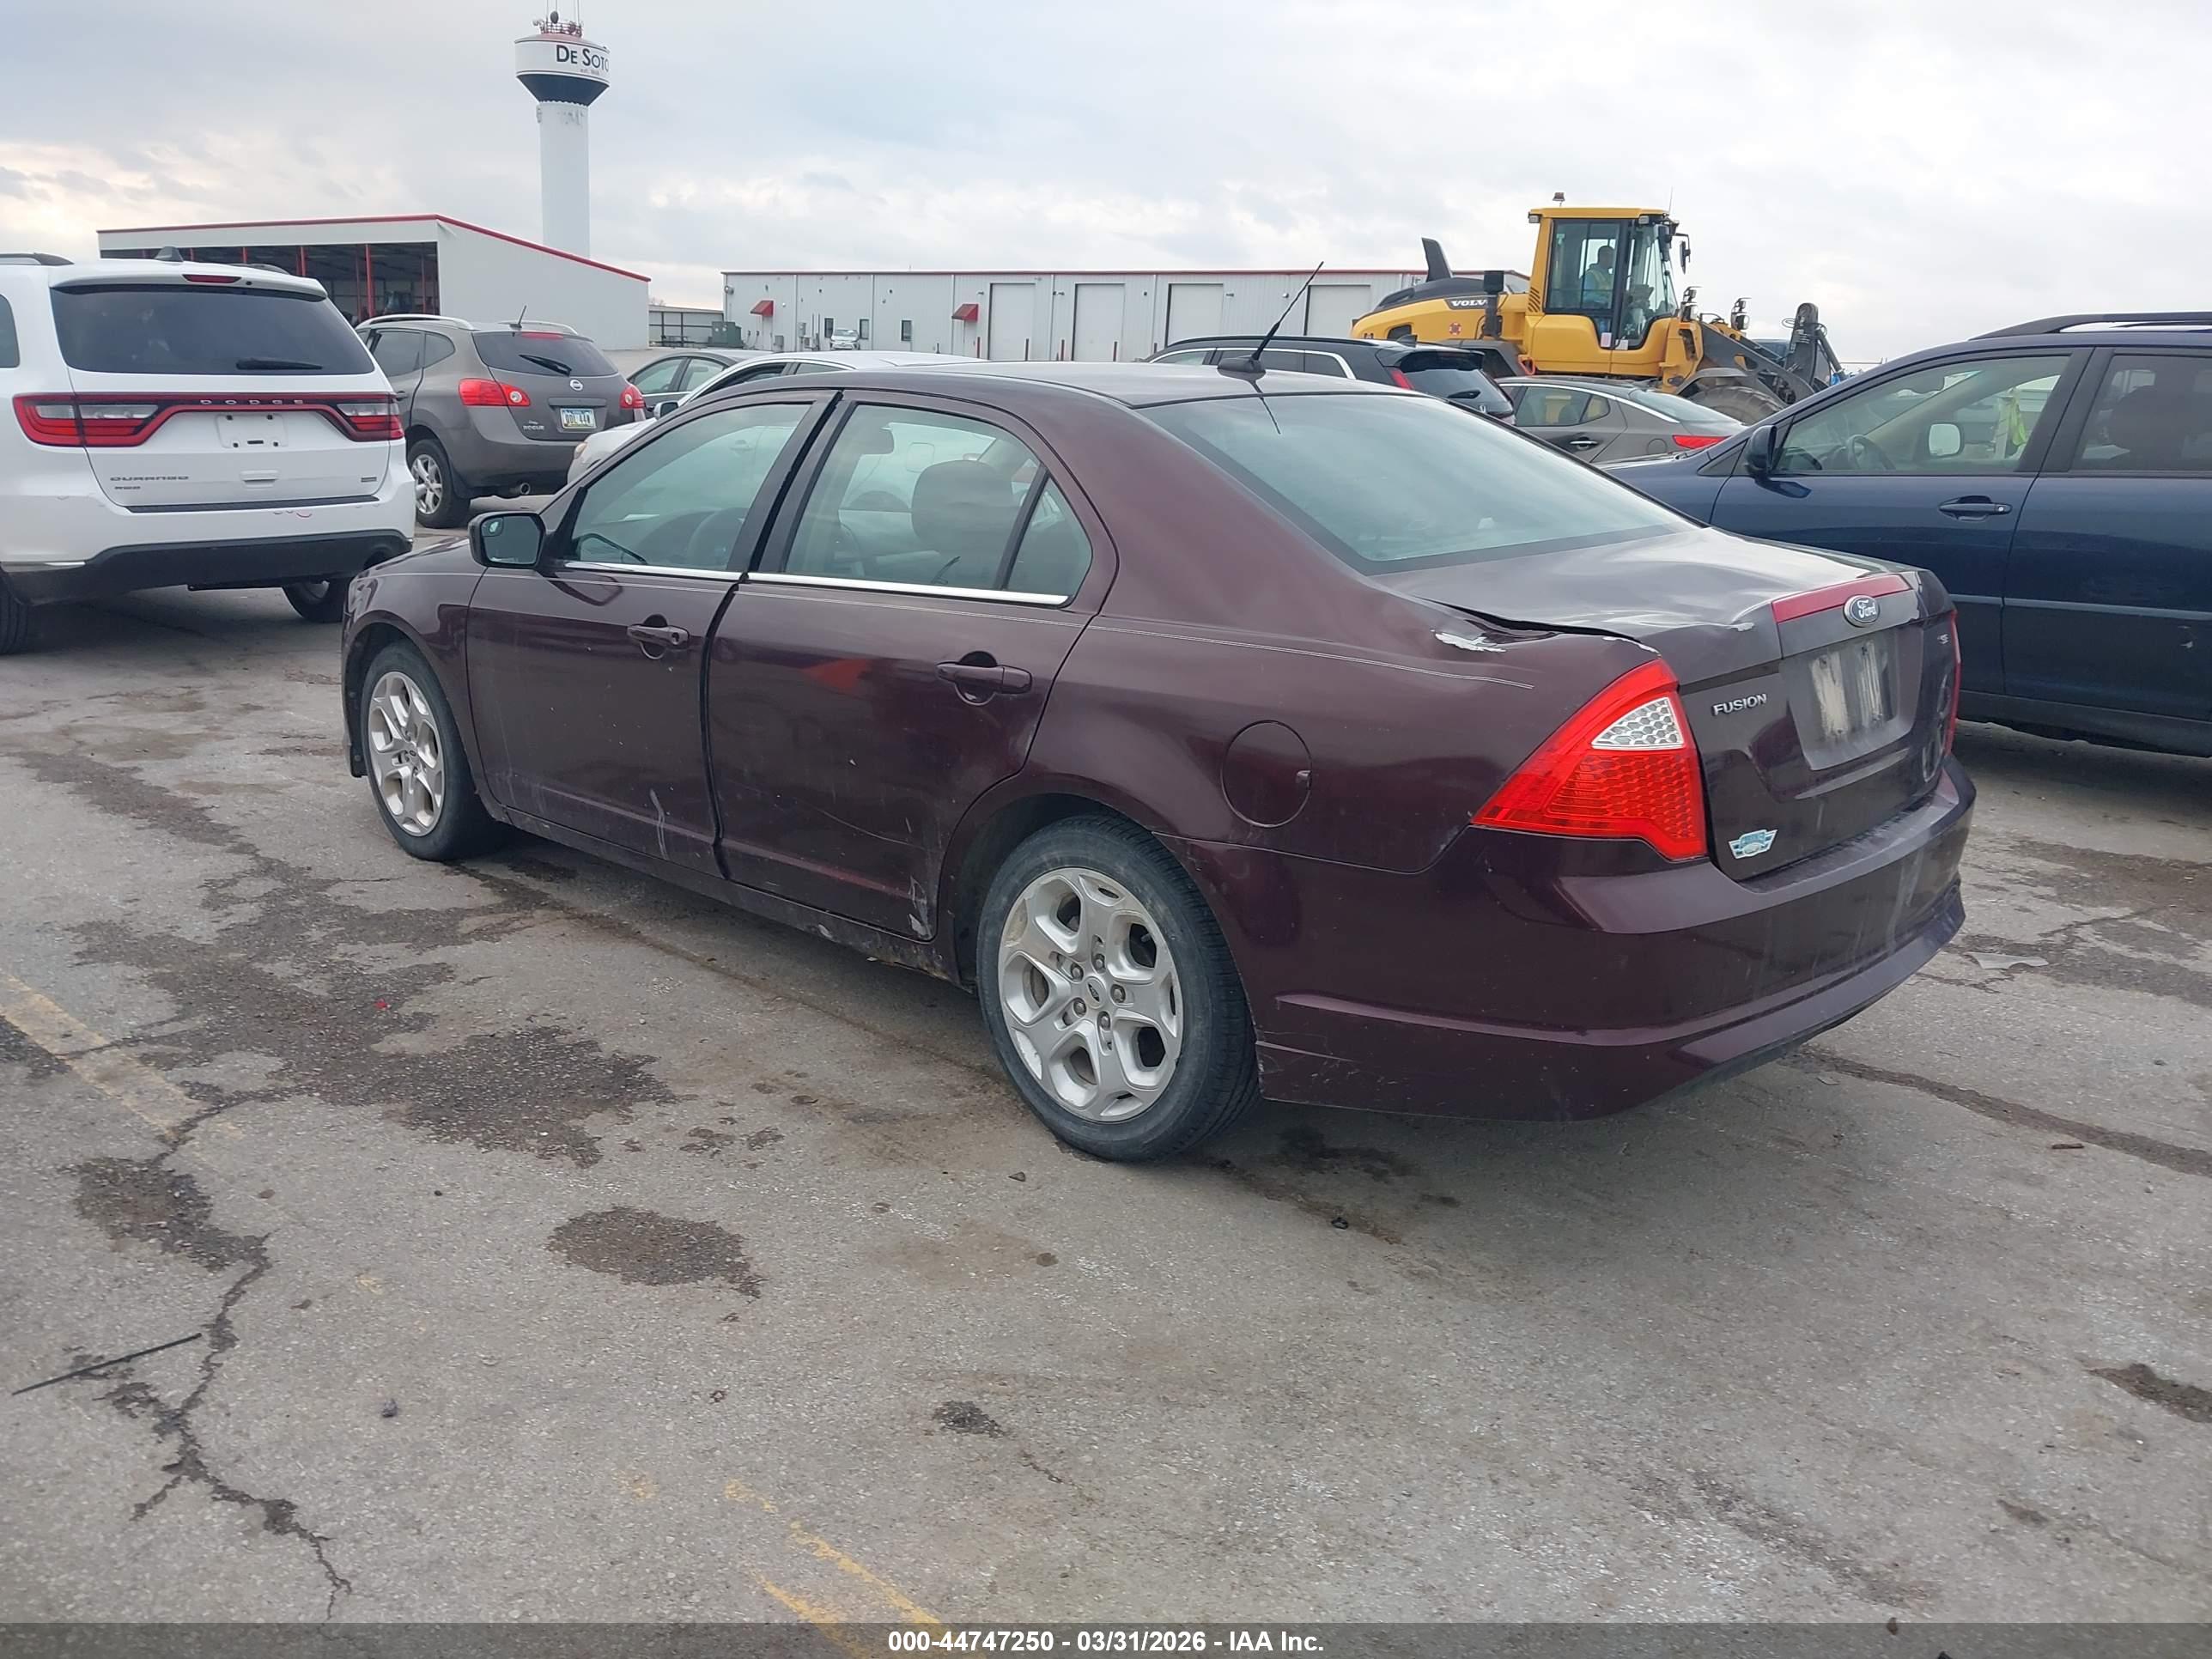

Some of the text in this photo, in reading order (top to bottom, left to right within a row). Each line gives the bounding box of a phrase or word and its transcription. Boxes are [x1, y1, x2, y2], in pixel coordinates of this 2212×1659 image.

[556, 45, 578, 64] DE
[1856, 599, 1877, 618] Ford
[1711, 693, 1768, 716] FUSION
